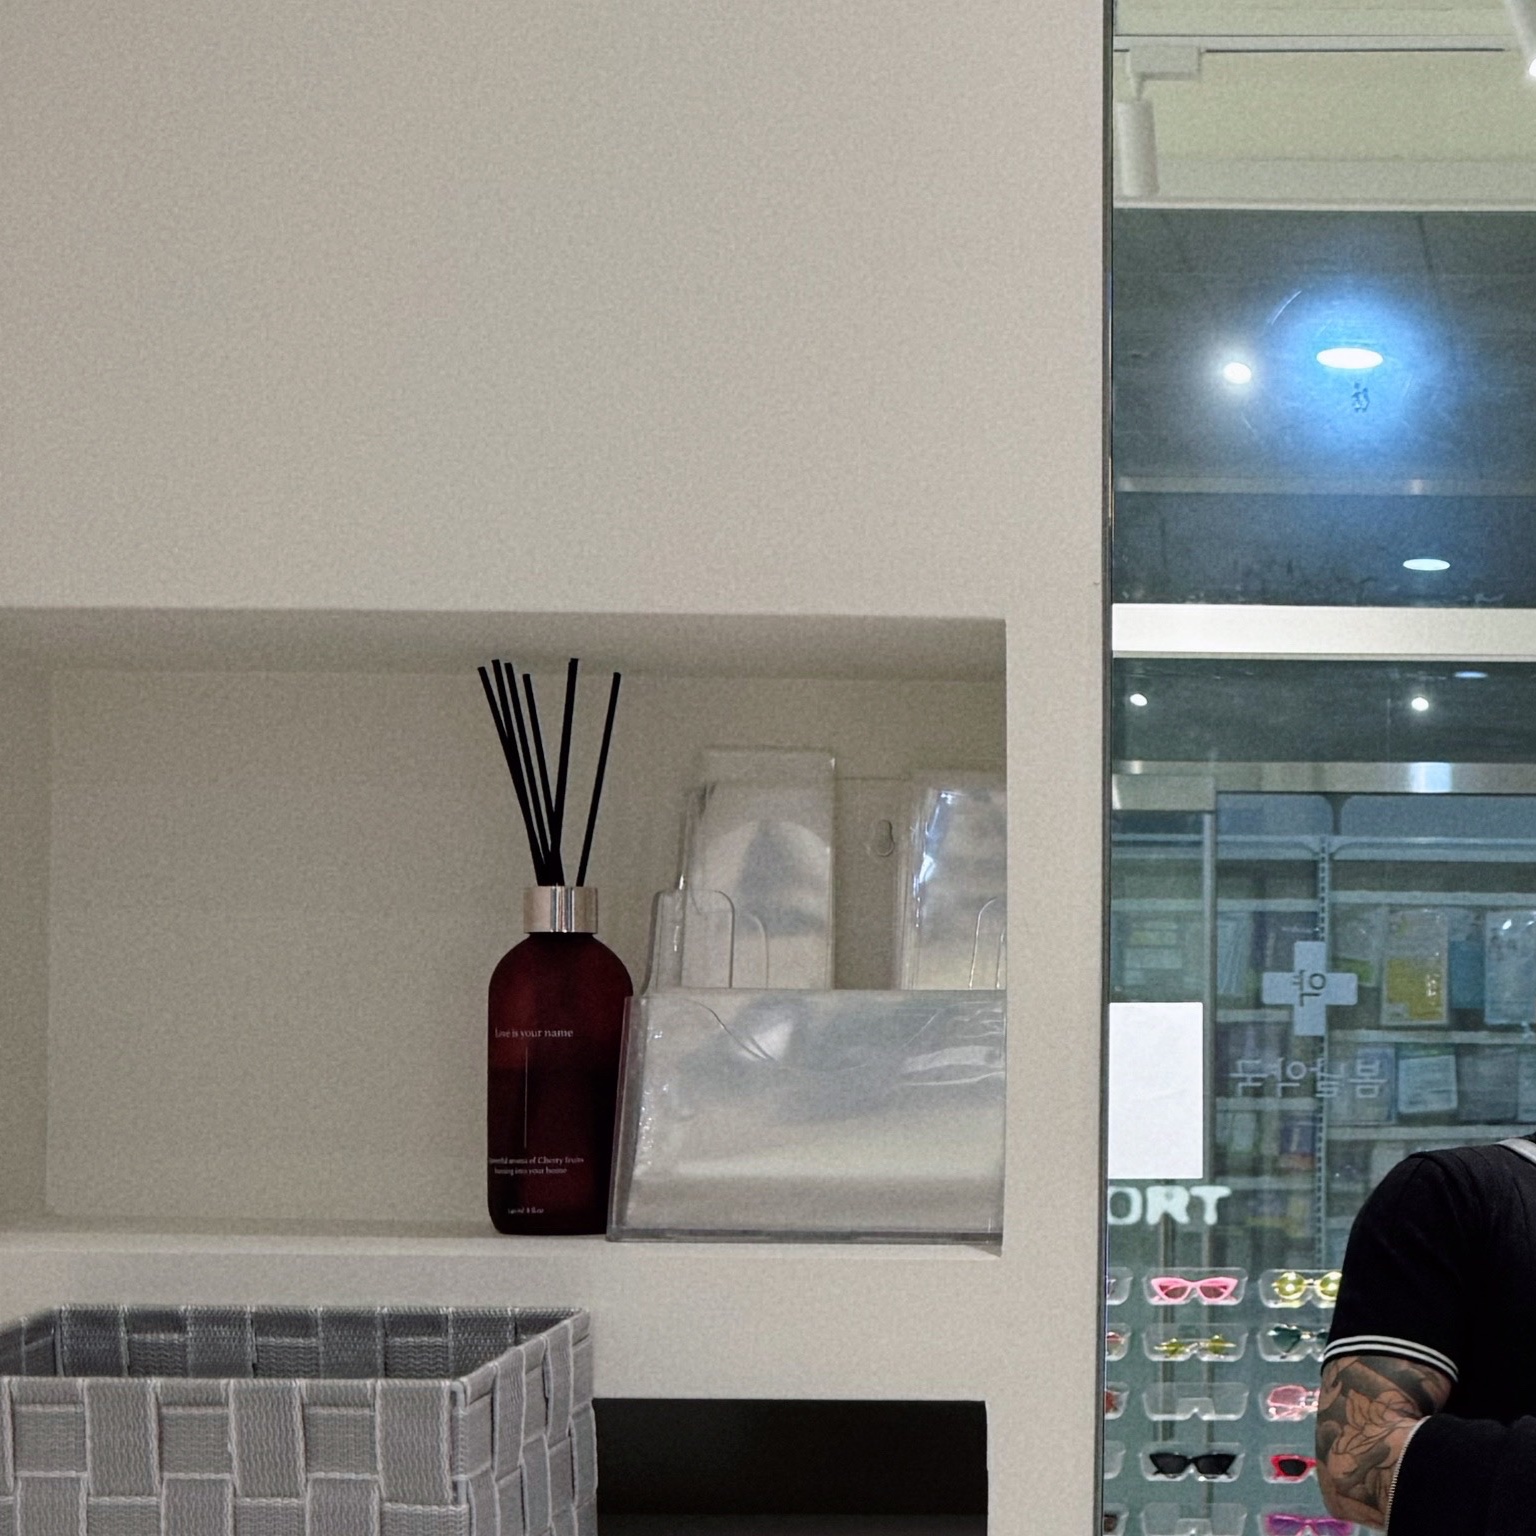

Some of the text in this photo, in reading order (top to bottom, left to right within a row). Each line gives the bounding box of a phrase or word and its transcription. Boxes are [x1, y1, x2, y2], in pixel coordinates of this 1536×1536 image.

[520, 1030, 543, 1040] your
[544, 1029, 574, 1038] name
[538, 1156, 563, 1165] Cherry
